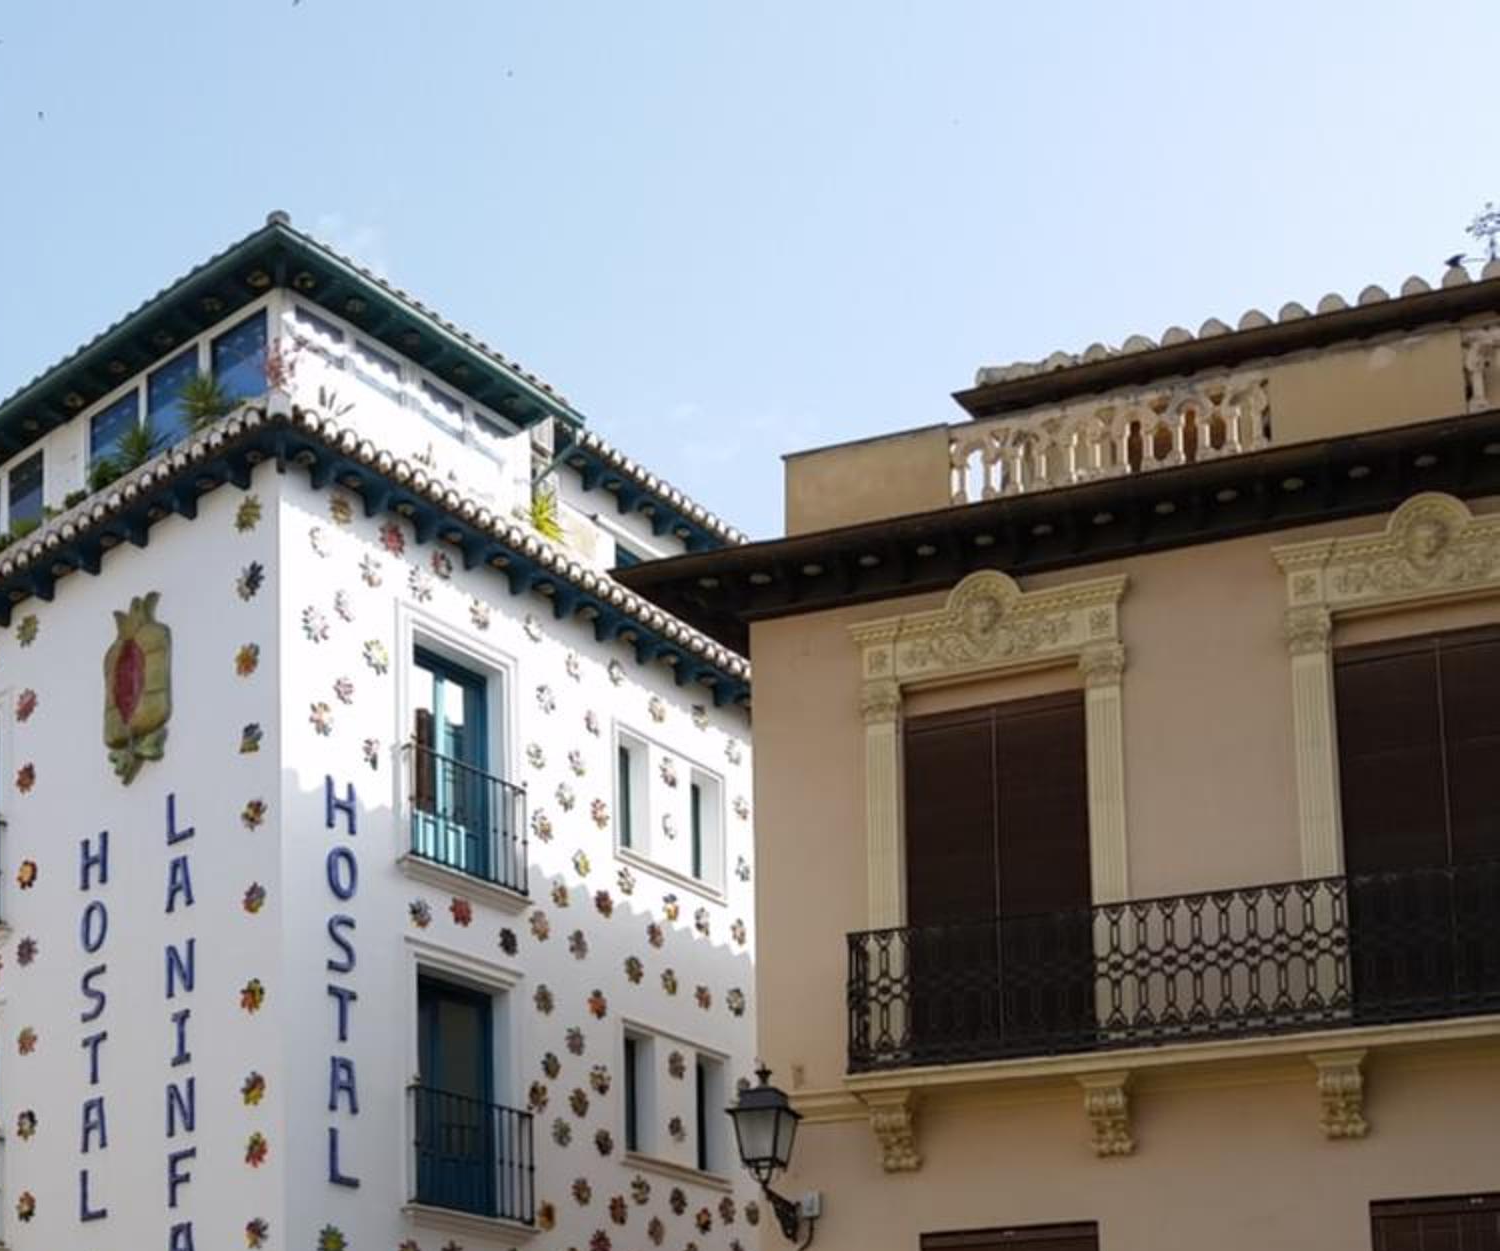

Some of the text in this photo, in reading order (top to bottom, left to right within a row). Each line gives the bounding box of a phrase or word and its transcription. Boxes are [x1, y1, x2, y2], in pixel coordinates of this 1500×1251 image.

[80, 831, 109, 1222] HOSTAL
[165, 793, 195, 913] LA
[326, 775, 360, 1189] HOSTAL
